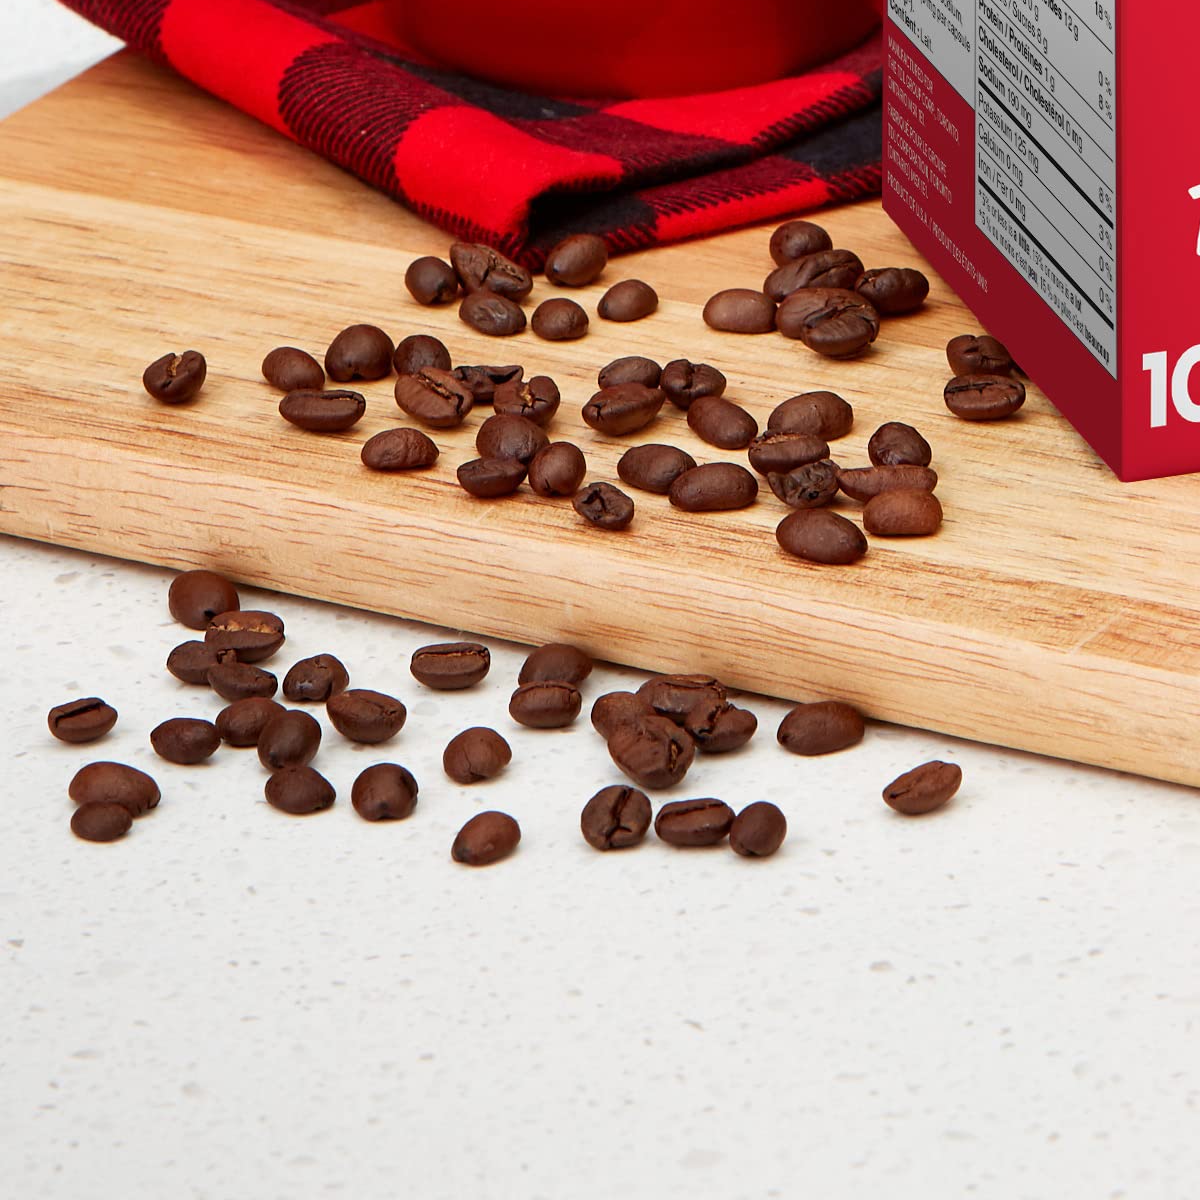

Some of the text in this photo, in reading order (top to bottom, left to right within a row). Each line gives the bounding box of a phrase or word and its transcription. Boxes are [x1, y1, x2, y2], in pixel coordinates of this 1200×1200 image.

[1064, 9, 1072, 32] 12
[1009, 25, 1042, 76] Protéines
[978, 55, 1004, 97] Sodium
[978, 24, 1064, 131] Cholesterol Cholestérol
[978, 91, 1012, 142] Potassium
[978, 121, 1004, 164] Calcium
[978, 152, 991, 180] Iron
